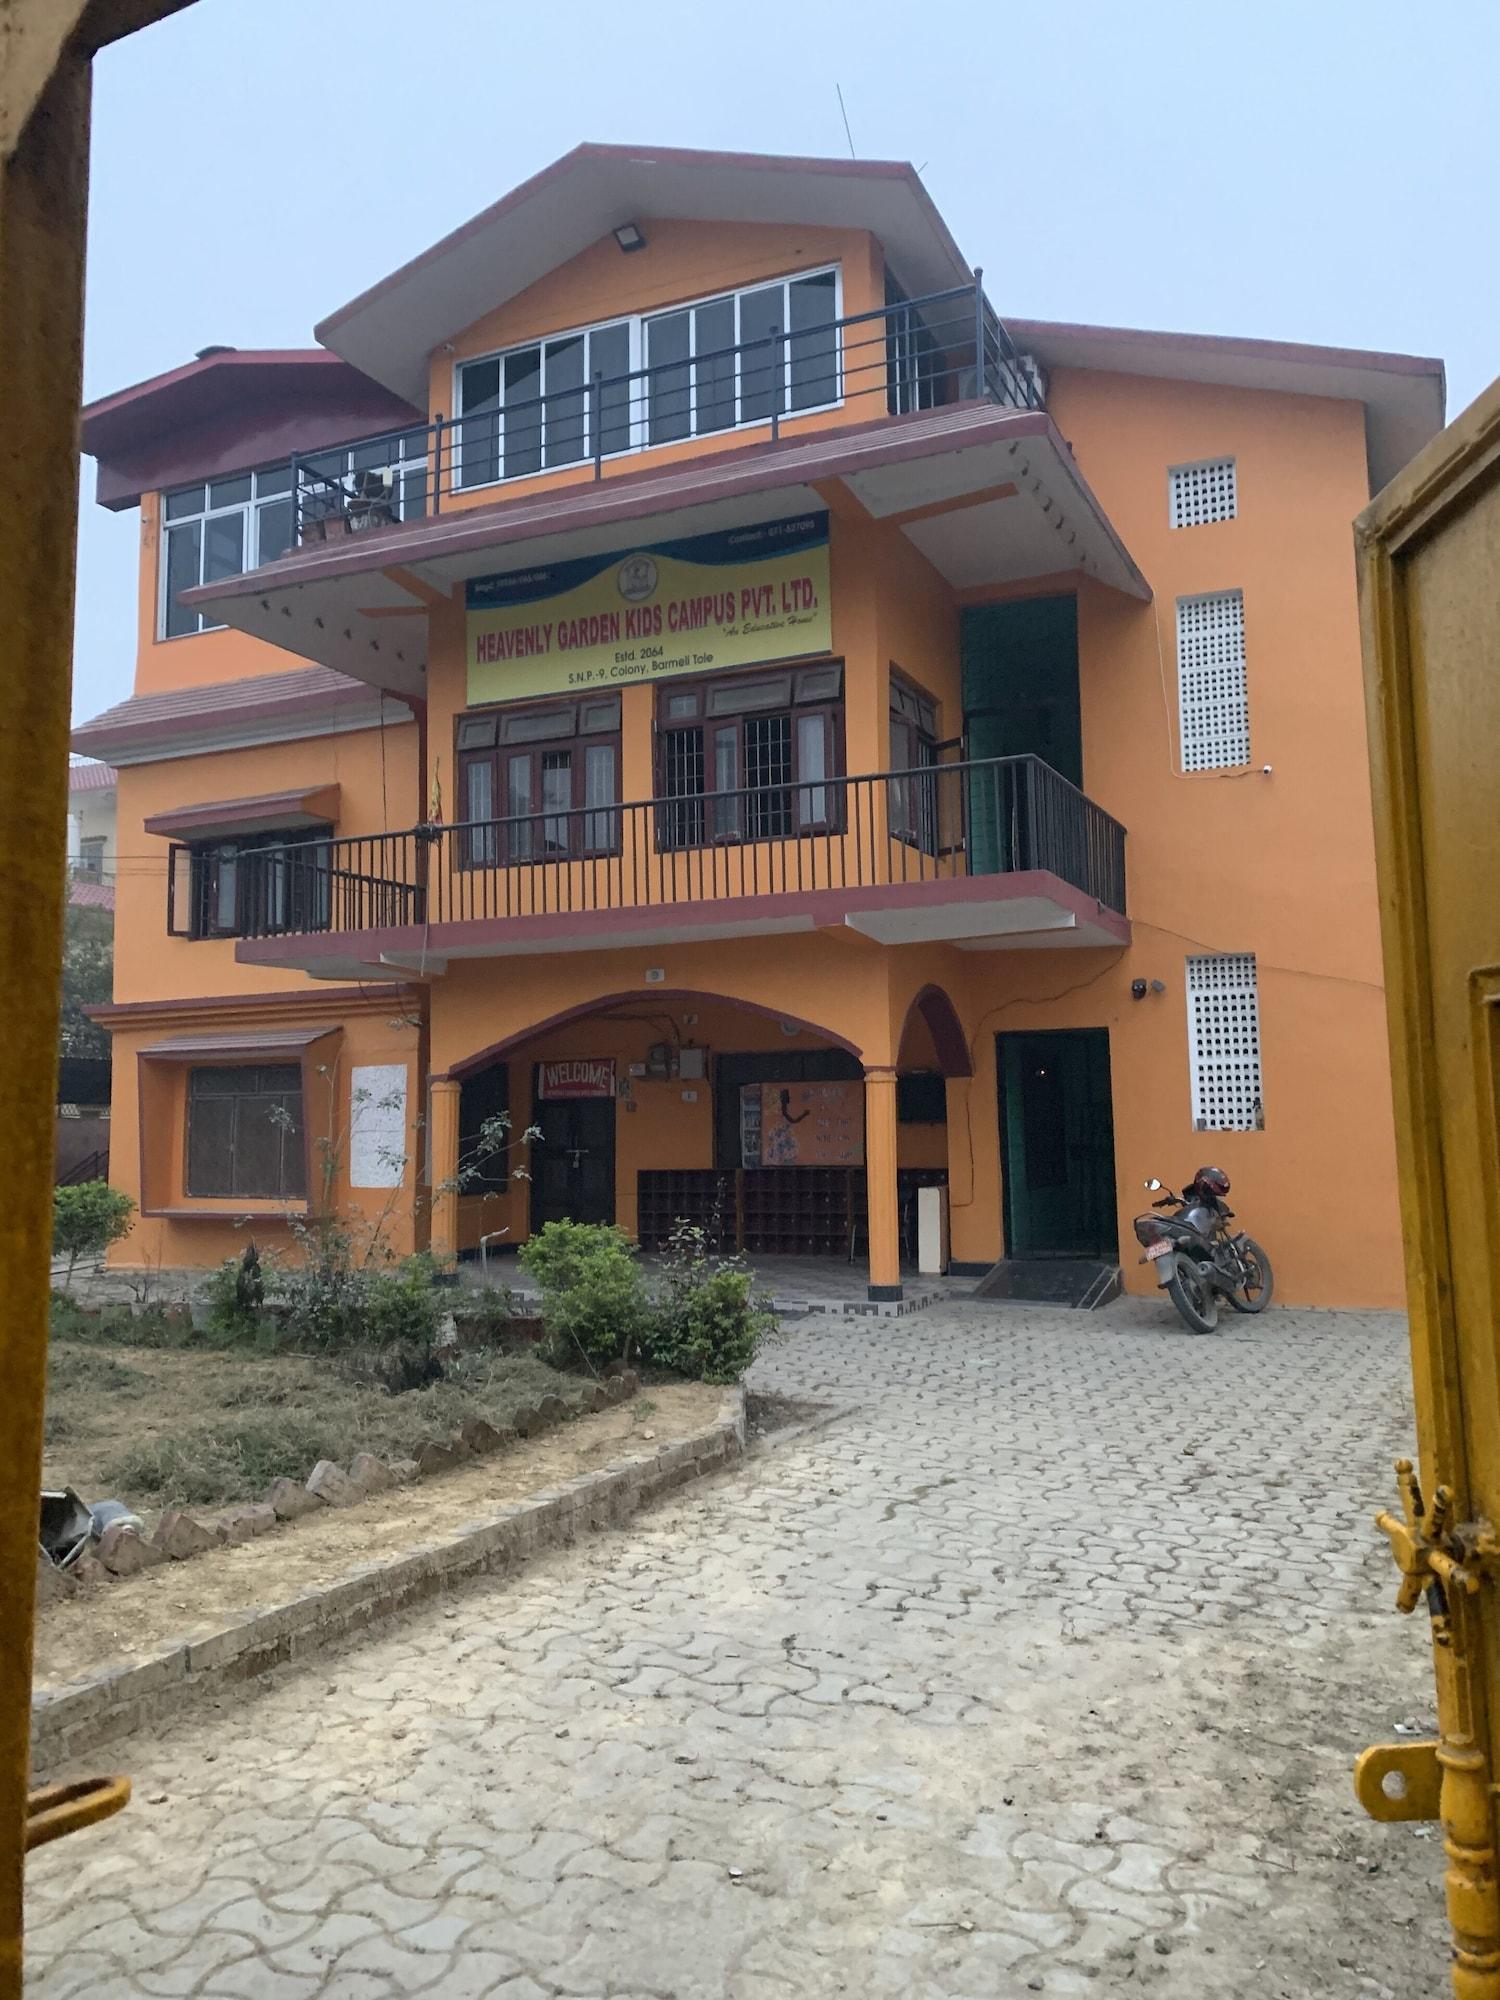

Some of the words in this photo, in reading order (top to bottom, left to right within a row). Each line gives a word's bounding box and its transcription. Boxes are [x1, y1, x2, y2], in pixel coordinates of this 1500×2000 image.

[476, 623, 553, 664] HEAVENLY
[557, 612, 620, 651] GARDEN
[626, 604, 662, 640] KIDS
[668, 591, 735, 633] CAMPUS
[741, 584, 776, 620] PVT.
[782, 577, 818, 613] LTD.
[615, 651, 637, 663] Estd.
[640, 646, 664, 660] 2064
[652, 656, 690, 671] Barmeli
[693, 652, 714, 666] Tole
[546, 1062, 610, 1089] WELCOME
